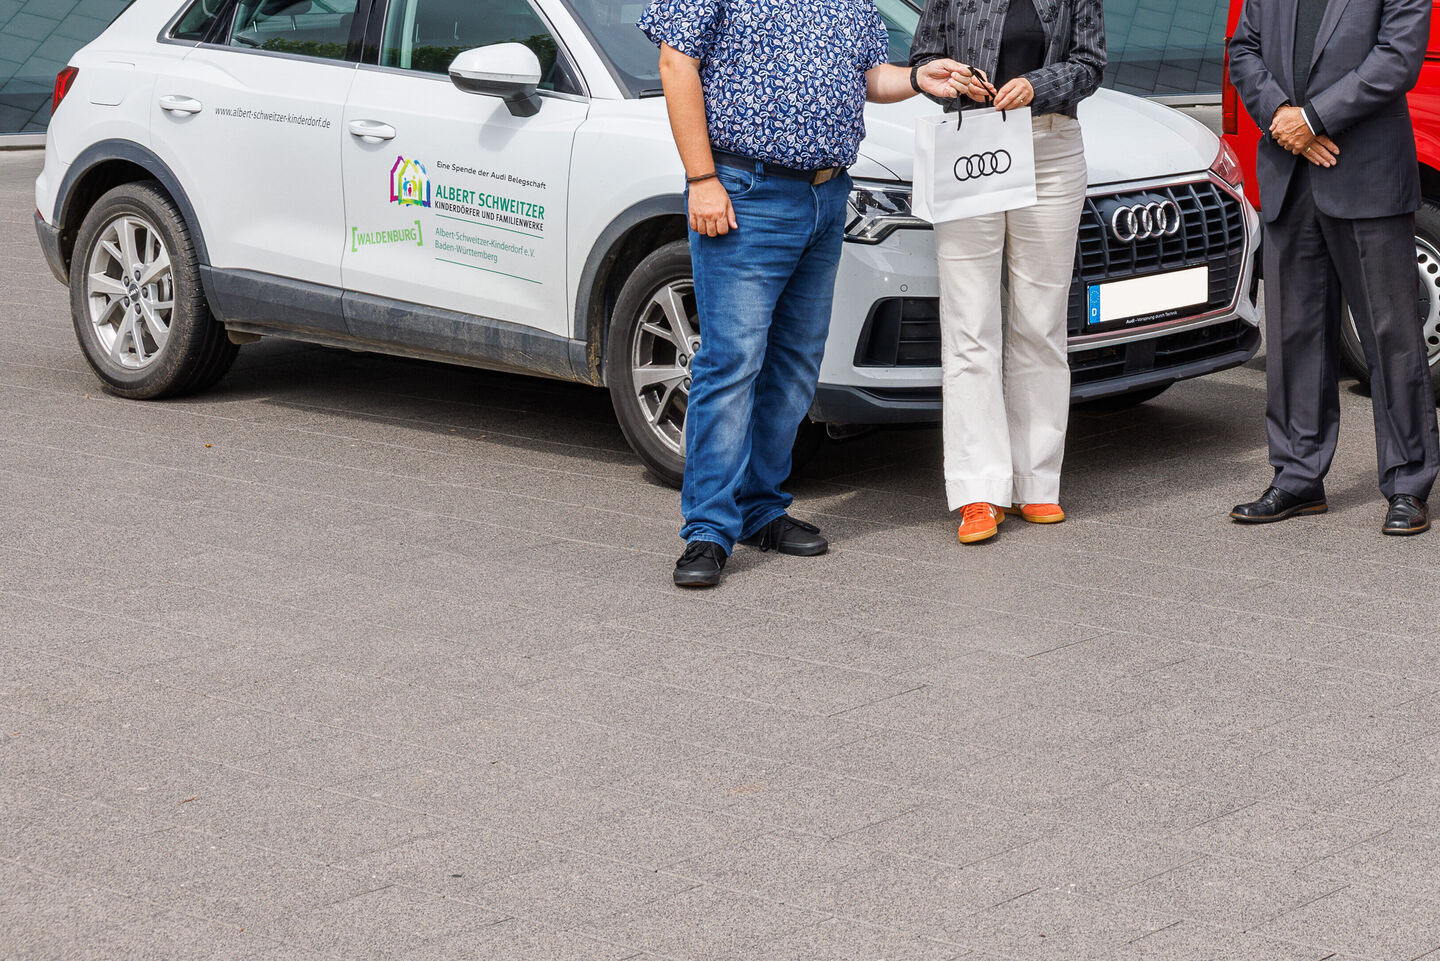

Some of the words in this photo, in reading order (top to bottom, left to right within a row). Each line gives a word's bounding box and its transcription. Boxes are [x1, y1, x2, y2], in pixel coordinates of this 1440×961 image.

[215, 106, 331, 129] www.albert-schweitzer-kinderdorf.de
[436, 160, 451, 170] Eine
[451, 163, 477, 175] Spende
[478, 169, 489, 177] der
[490, 171, 507, 181] Audi
[507, 174, 547, 190] Belegschaft
[434, 200, 480, 218] KINDERDÖRFER
[481, 210, 495, 221] UND
[495, 213, 544, 232] FAMILIENWERKE
[435, 184, 476, 205] ALBERT
[478, 192, 545, 220] SCHWEITZER
[434, 239, 498, 263] Baden-Württemberg
[435, 227, 524, 255] Albert-Schweitzer-Kinderdorf
[523, 247, 536, 258] e.V.
